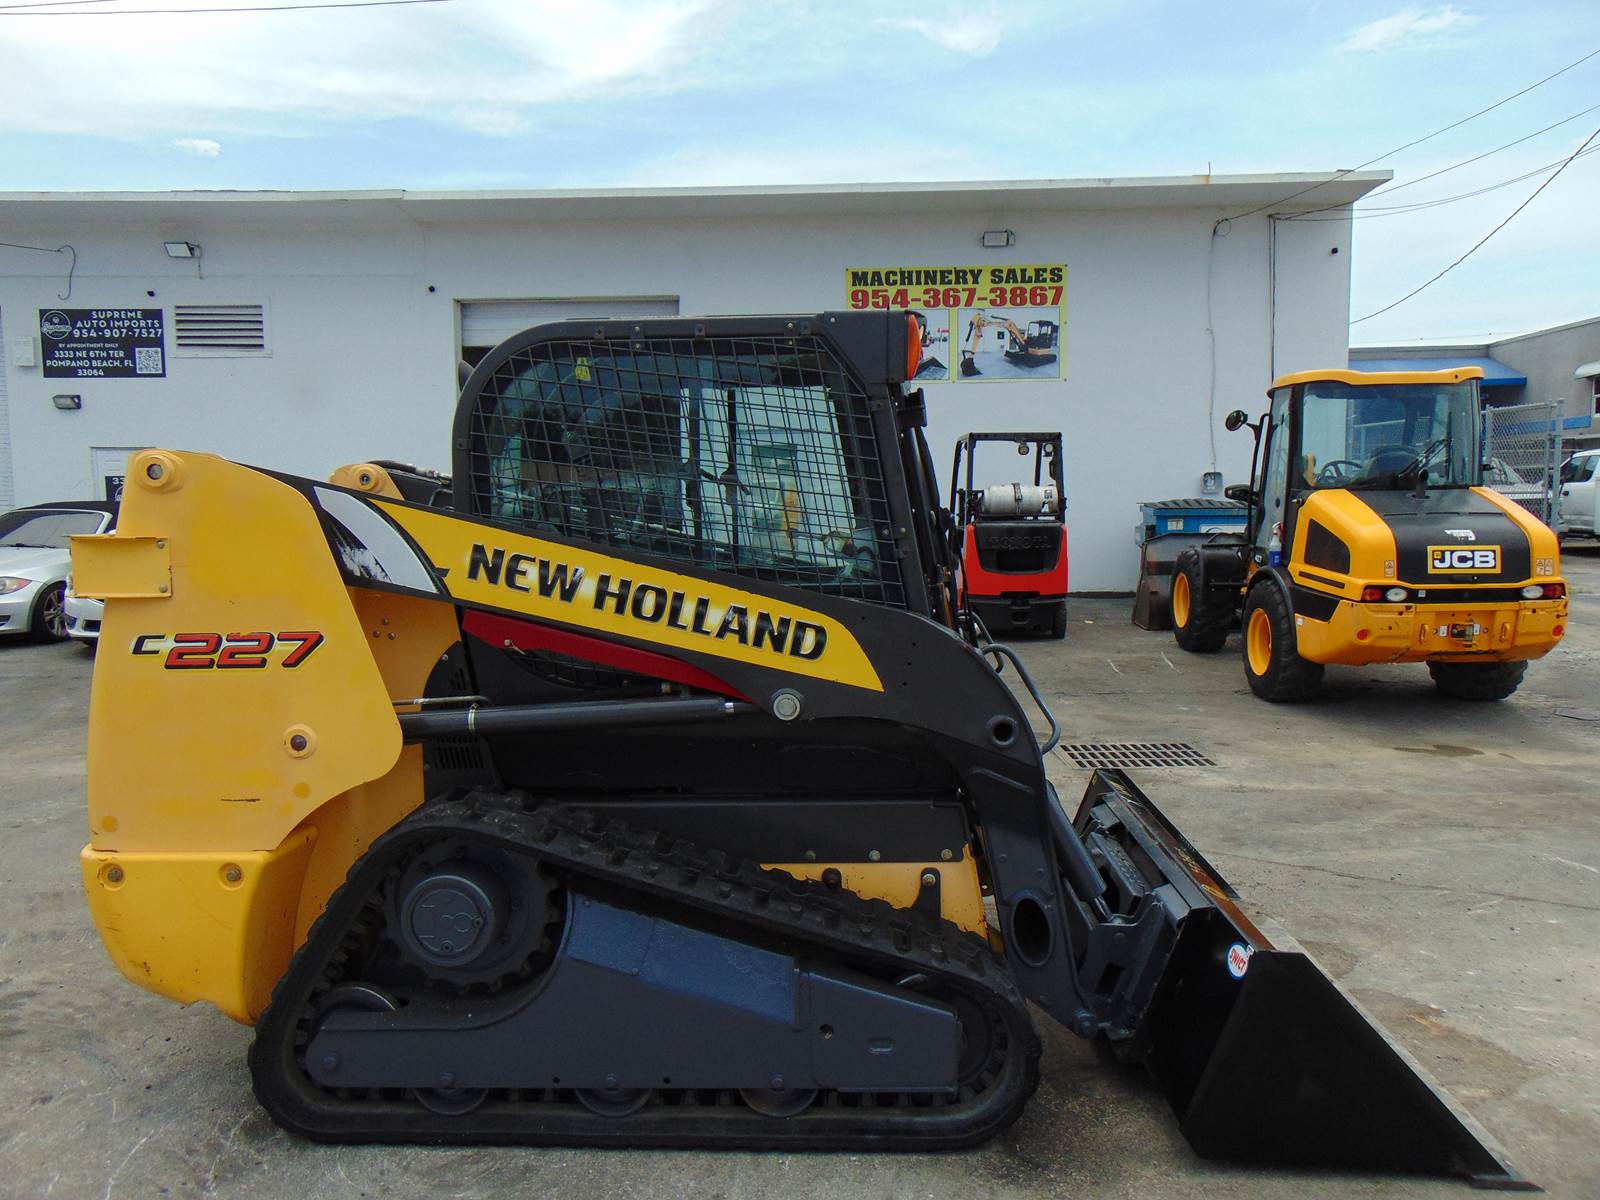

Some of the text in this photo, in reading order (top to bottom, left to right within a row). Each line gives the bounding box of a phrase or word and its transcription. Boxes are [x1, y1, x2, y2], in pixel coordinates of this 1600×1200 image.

[851, 267, 1063, 287] MACHINERY SALES
[850, 286, 1064, 309] 954-367-3867
[91, 310, 143, 319] SUPREME
[76, 319, 107, 328] AUTO
[110, 319, 160, 328] IMPORTS
[73, 328, 163, 338] 954-907-7527
[54, 350, 125, 358] 3333 NE 6TH TER
[46, 359, 134, 368] POMPANO BEACH, FL
[76, 368, 105, 377] 33064
[1433, 550, 1496, 568] JCB
[466, 543, 828, 661] NEW HOLLAND
